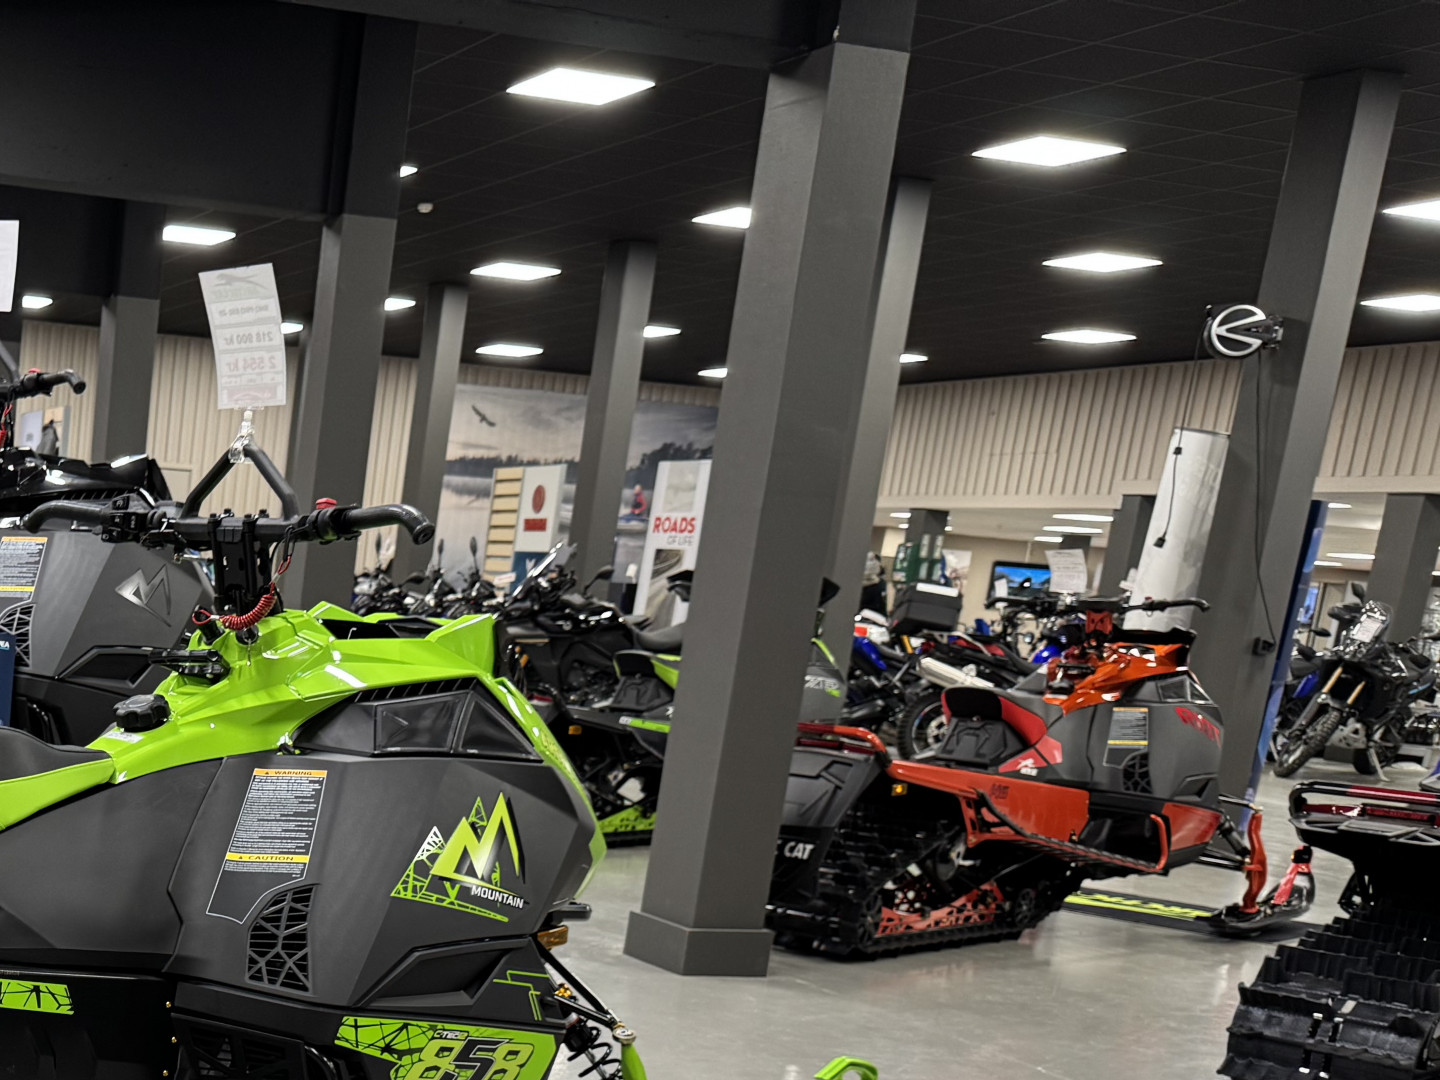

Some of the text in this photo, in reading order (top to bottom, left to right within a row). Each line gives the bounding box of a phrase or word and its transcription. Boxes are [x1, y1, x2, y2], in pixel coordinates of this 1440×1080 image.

[652, 517, 697, 533] ROADS
[784, 841, 815, 860] CAT
[471, 885, 524, 909] MOUNTAIN
